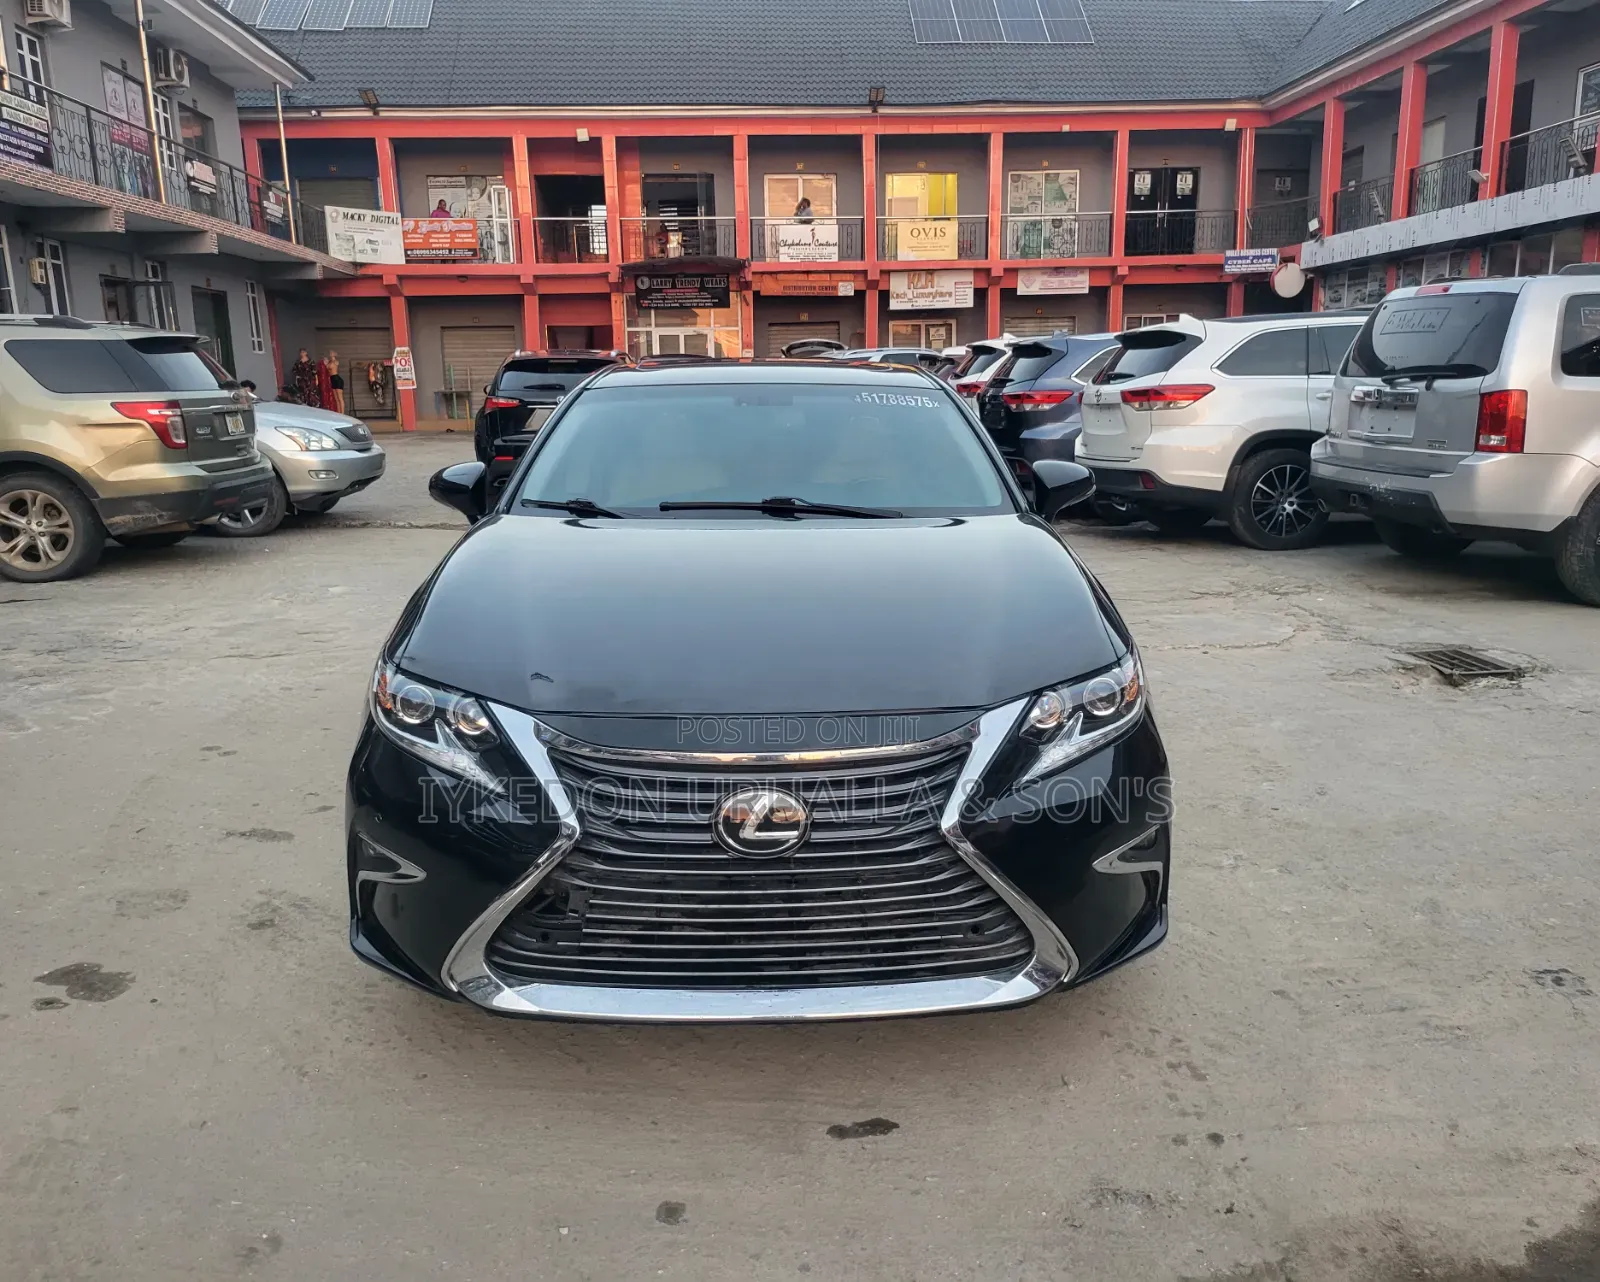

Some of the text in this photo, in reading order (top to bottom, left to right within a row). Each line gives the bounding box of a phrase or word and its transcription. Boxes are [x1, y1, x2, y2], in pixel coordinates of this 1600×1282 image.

[342, 211, 400, 226] MACKY DIGITAL
[910, 227, 947, 239] OVIS
[675, 278, 701, 288] TRENDY
[703, 277, 728, 288] WEARS
